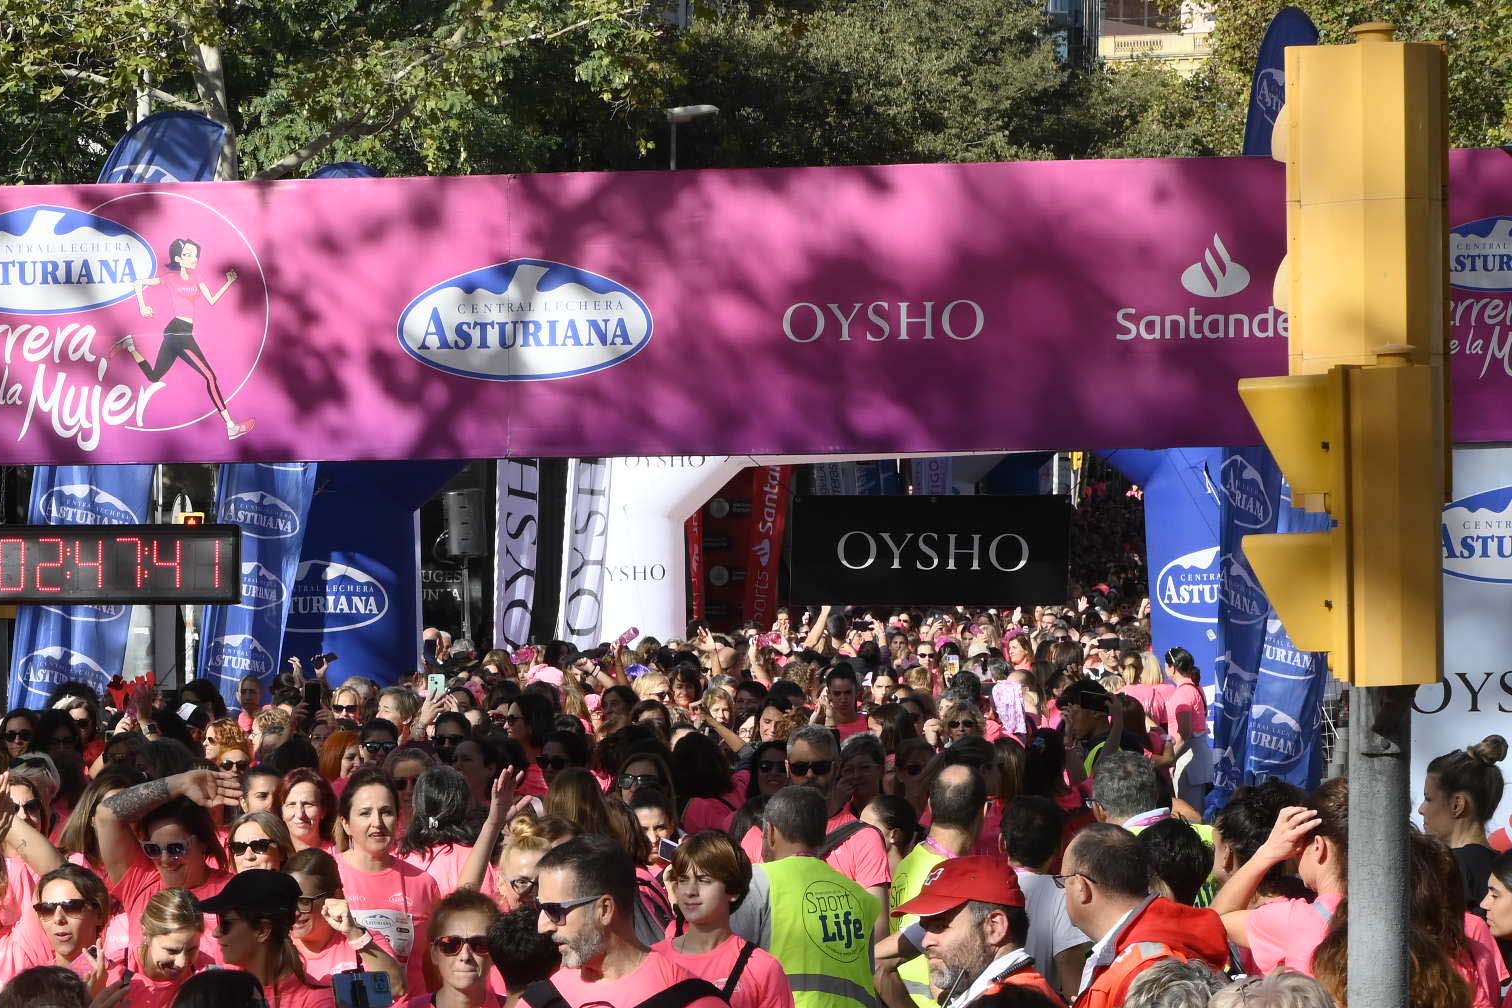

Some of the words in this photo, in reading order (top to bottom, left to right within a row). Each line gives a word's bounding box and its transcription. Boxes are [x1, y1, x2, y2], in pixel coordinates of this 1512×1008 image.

[60, 241, 132, 253] LECHERA
[457, 301, 536, 315] CENTRAL
[544, 300, 625, 312] LECHERA
[782, 299, 985, 343] OYSHO
[418, 306, 633, 350] ASTURIANA
[1116, 306, 1289, 342] Santande
[0, 365, 23, 406] la
[17, 359, 167, 452] Mujer
[836, 530, 1030, 572] OYSHO
[604, 563, 666, 582] YSHO
[1180, 573, 1220, 582] CENTRA
[326, 584, 375, 593] LECHERA
[290, 595, 379, 614] TURIANA
[805, 891, 854, 915] Sport
[819, 911, 865, 949] Life
